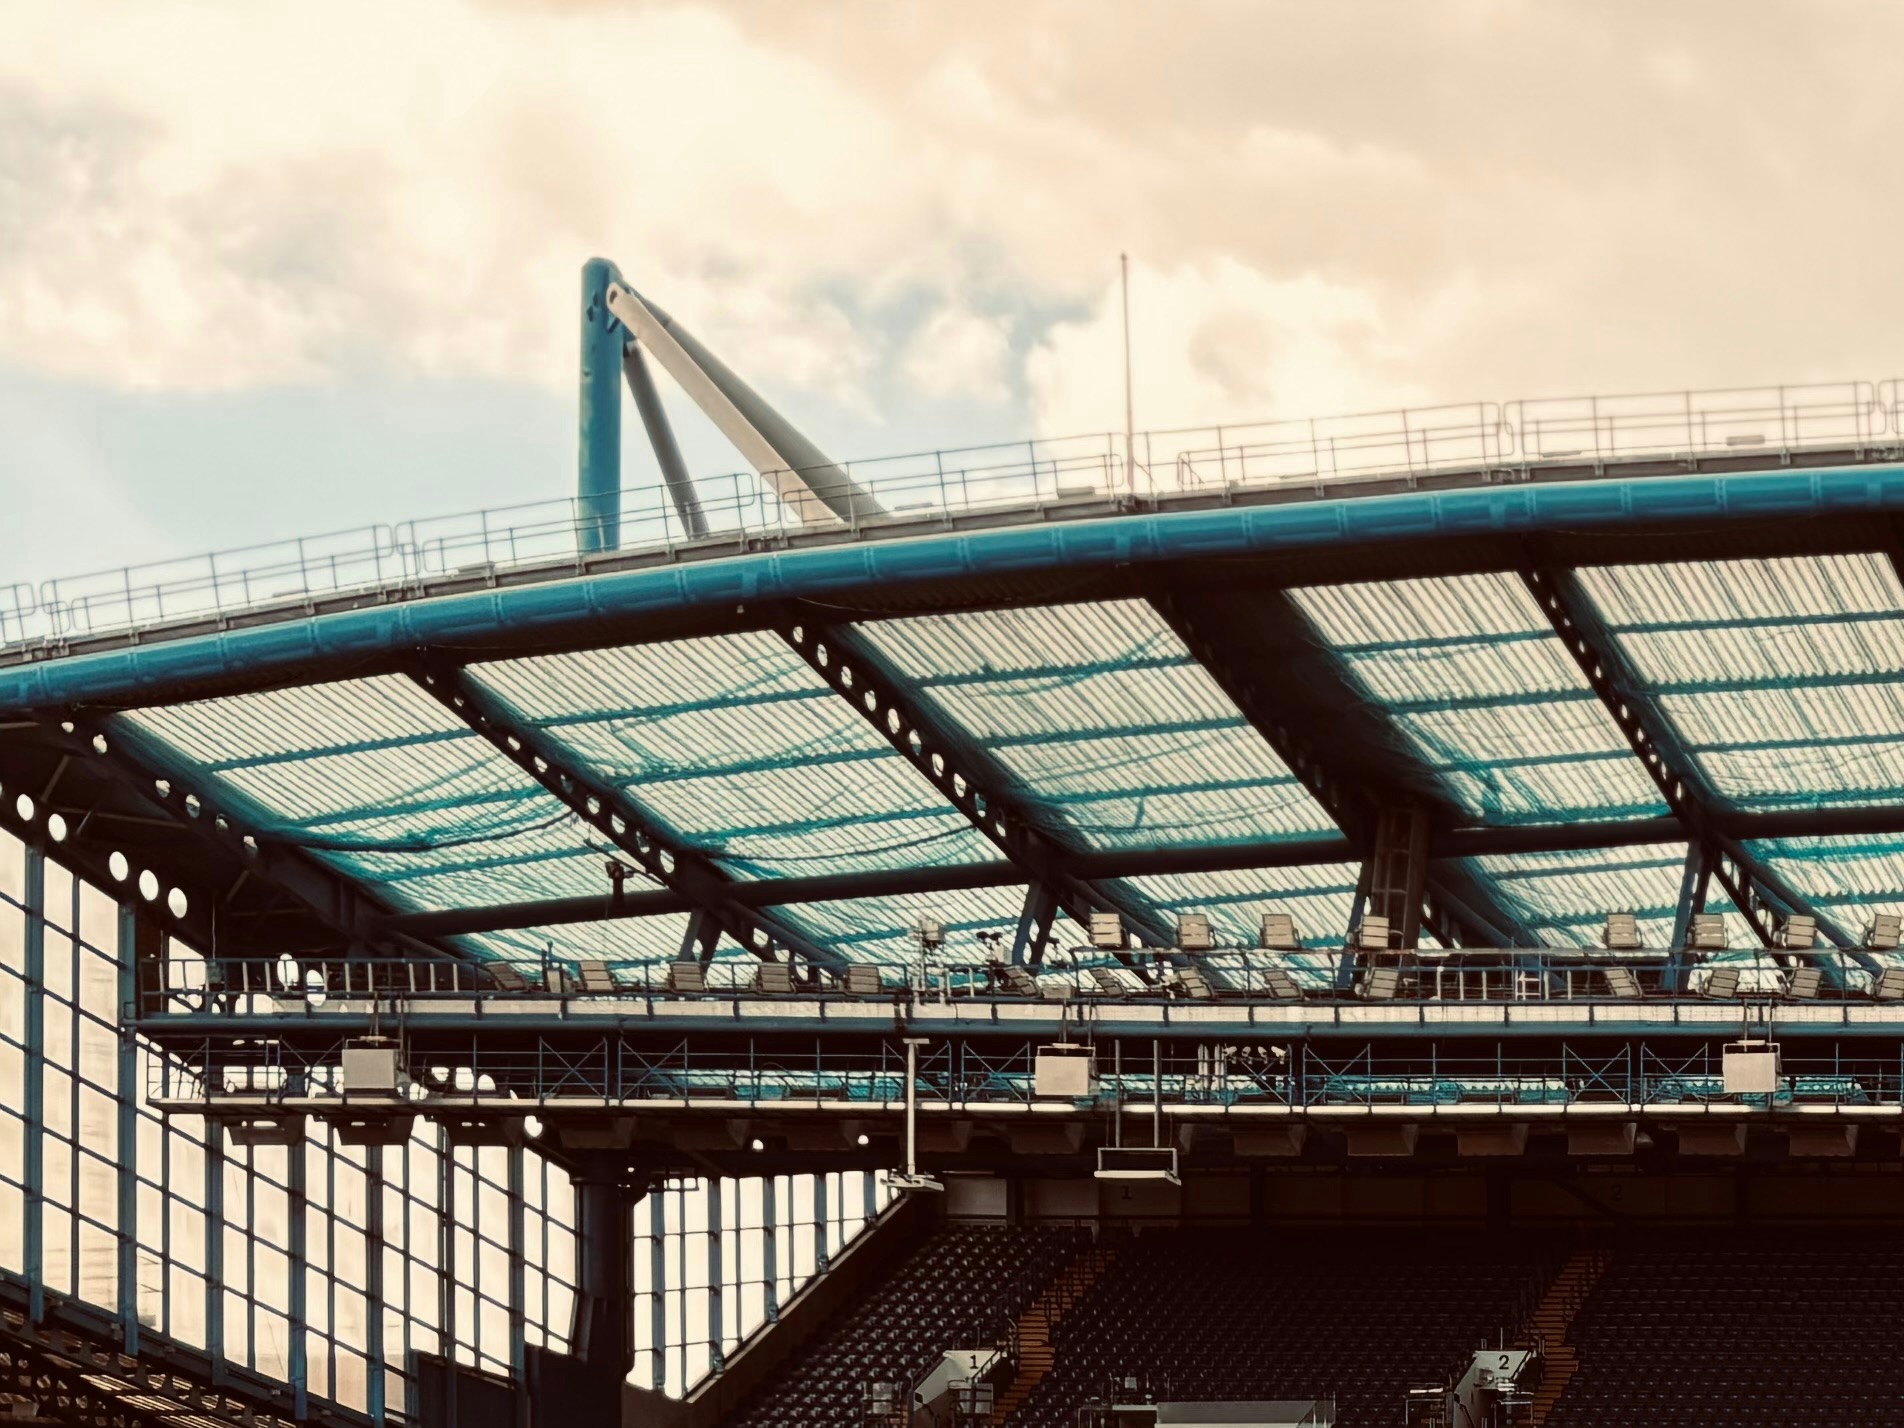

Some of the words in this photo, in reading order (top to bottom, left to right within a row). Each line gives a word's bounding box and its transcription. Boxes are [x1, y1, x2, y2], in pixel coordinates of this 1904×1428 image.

[1121, 1186, 1132, 1200] 1
[1610, 1184, 1623, 1201] 2
[970, 1355, 979, 1369] 1
[1498, 1355, 1510, 1370] 2
